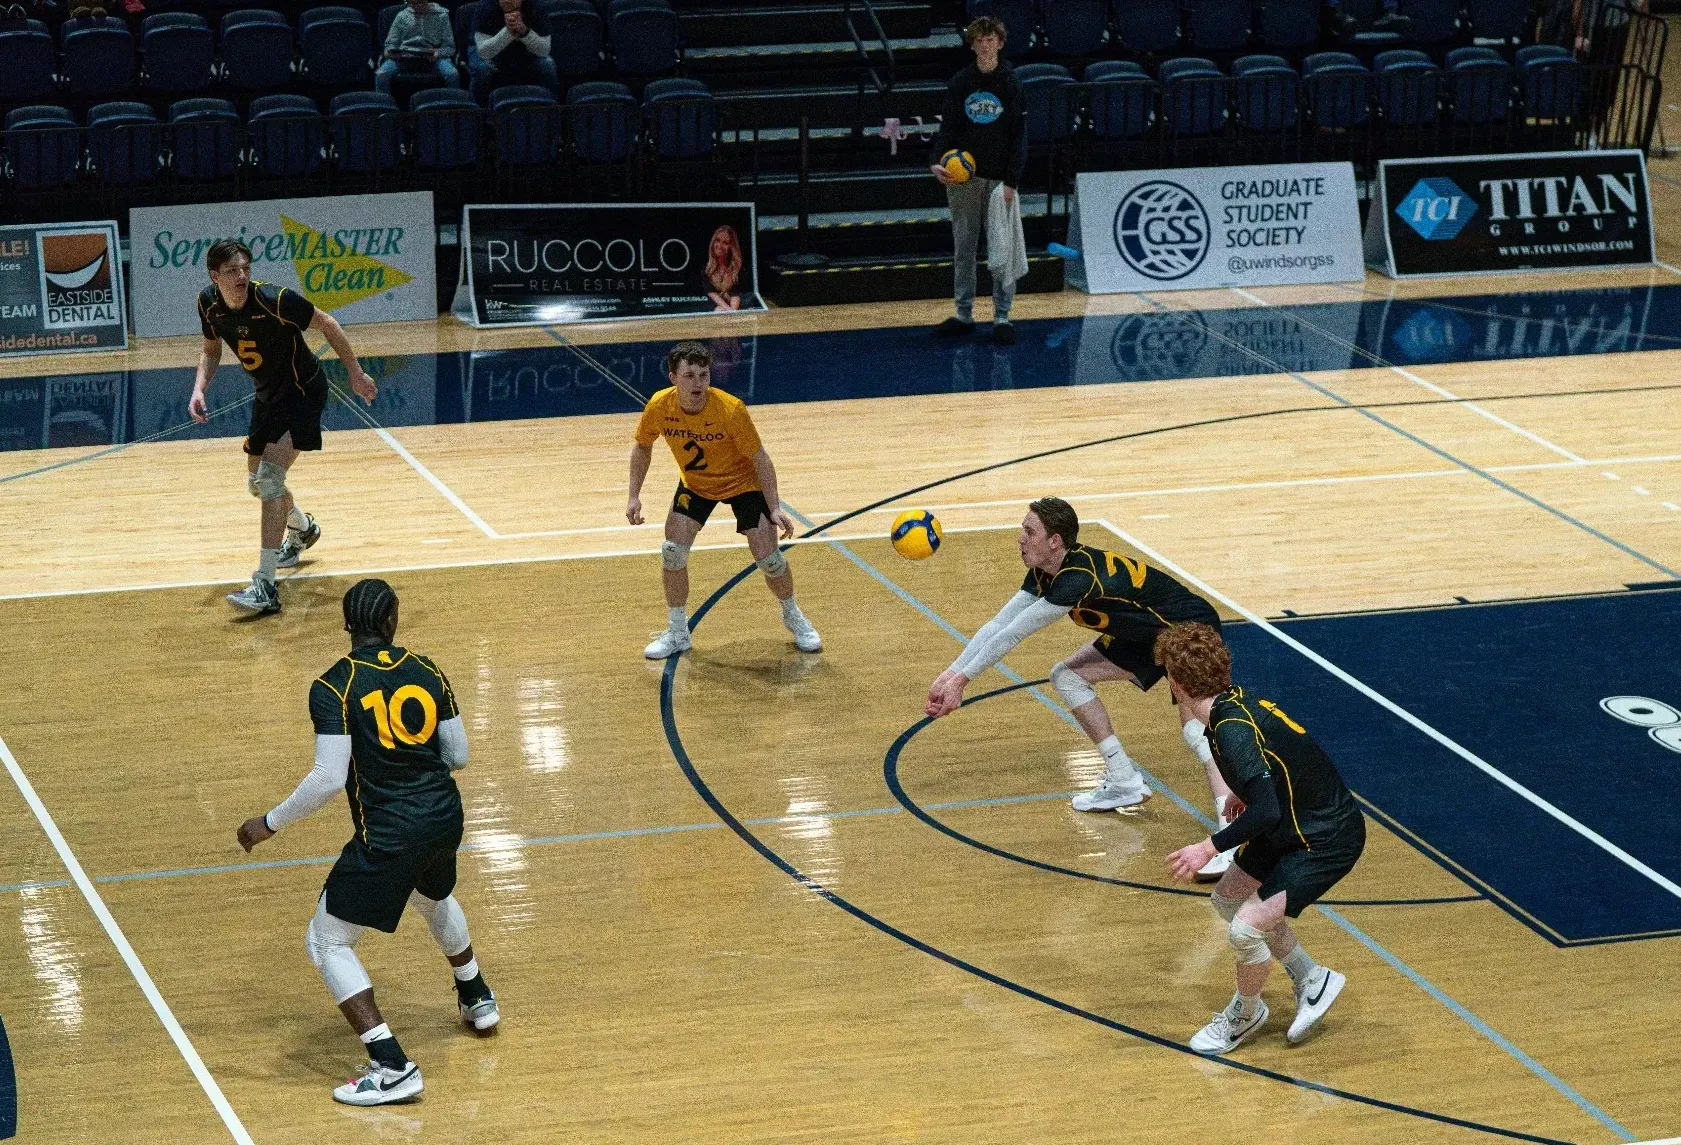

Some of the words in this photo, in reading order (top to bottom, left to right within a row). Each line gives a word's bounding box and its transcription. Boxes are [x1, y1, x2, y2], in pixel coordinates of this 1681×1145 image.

[1221, 177, 1325, 200] GRADUATE
[1479, 173, 1637, 220] TITAN
[1223, 202, 1312, 224] STUDENT
[1410, 196, 1461, 222] TCI
[1144, 215, 1203, 245] GSS
[1490, 216, 1637, 235] GROUP
[150, 226, 405, 269] SericeMASTER
[1226, 226, 1306, 248] SOCIETY
[1498, 240, 1634, 256] WWW.TCIWINDSOR.COM
[487, 238, 690, 273] RUCCOLO
[1227, 253, 1335, 274] @uwindsorgss
[304, 262, 386, 293] Clean
[529, 279, 573, 293] REAL
[584, 278, 648, 292] ESTATE
[48, 289, 112, 306] EASTSIDE
[48, 304, 115, 324] DENTAL
[0, 331, 98, 350] idedental.ca
[237, 341, 263, 371] 5
[663, 428, 724, 441] WATERLOO
[683, 440, 708, 471] 2
[360, 685, 437, 750] 10
